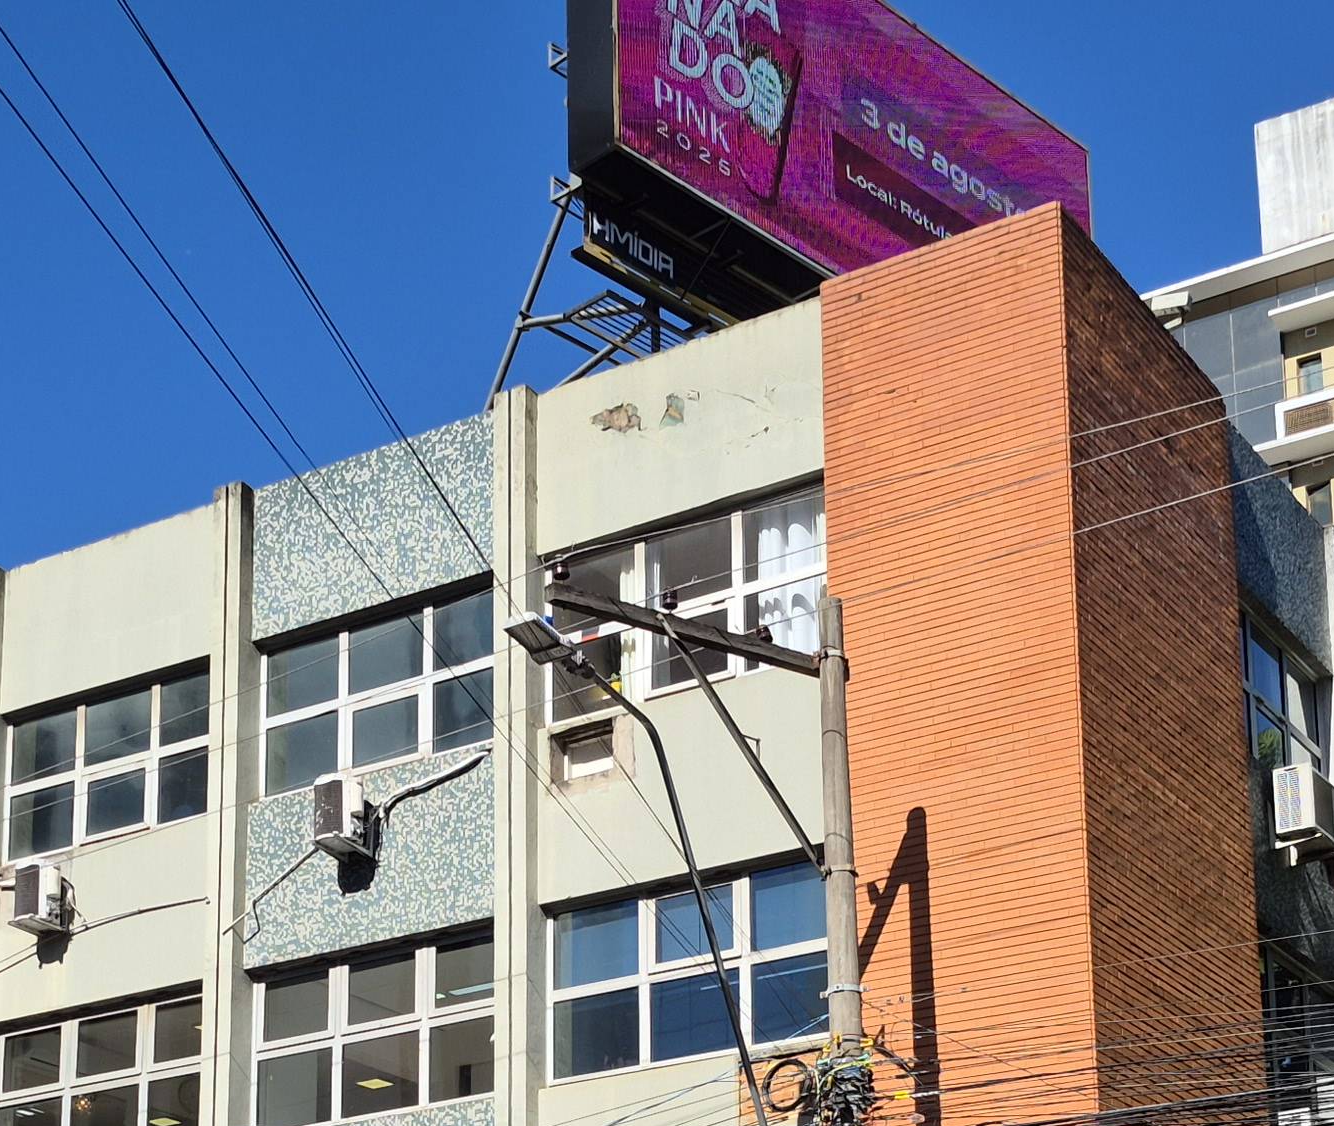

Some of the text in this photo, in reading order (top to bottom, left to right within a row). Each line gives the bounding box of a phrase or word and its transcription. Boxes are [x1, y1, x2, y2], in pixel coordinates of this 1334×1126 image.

[669, 18, 755, 109] DO
[654, 75, 731, 153] PINK
[861, 98, 880, 130] 3
[887, 119, 926, 160] de
[656, 119, 731, 176] 2025
[846, 164, 897, 210] Local:
